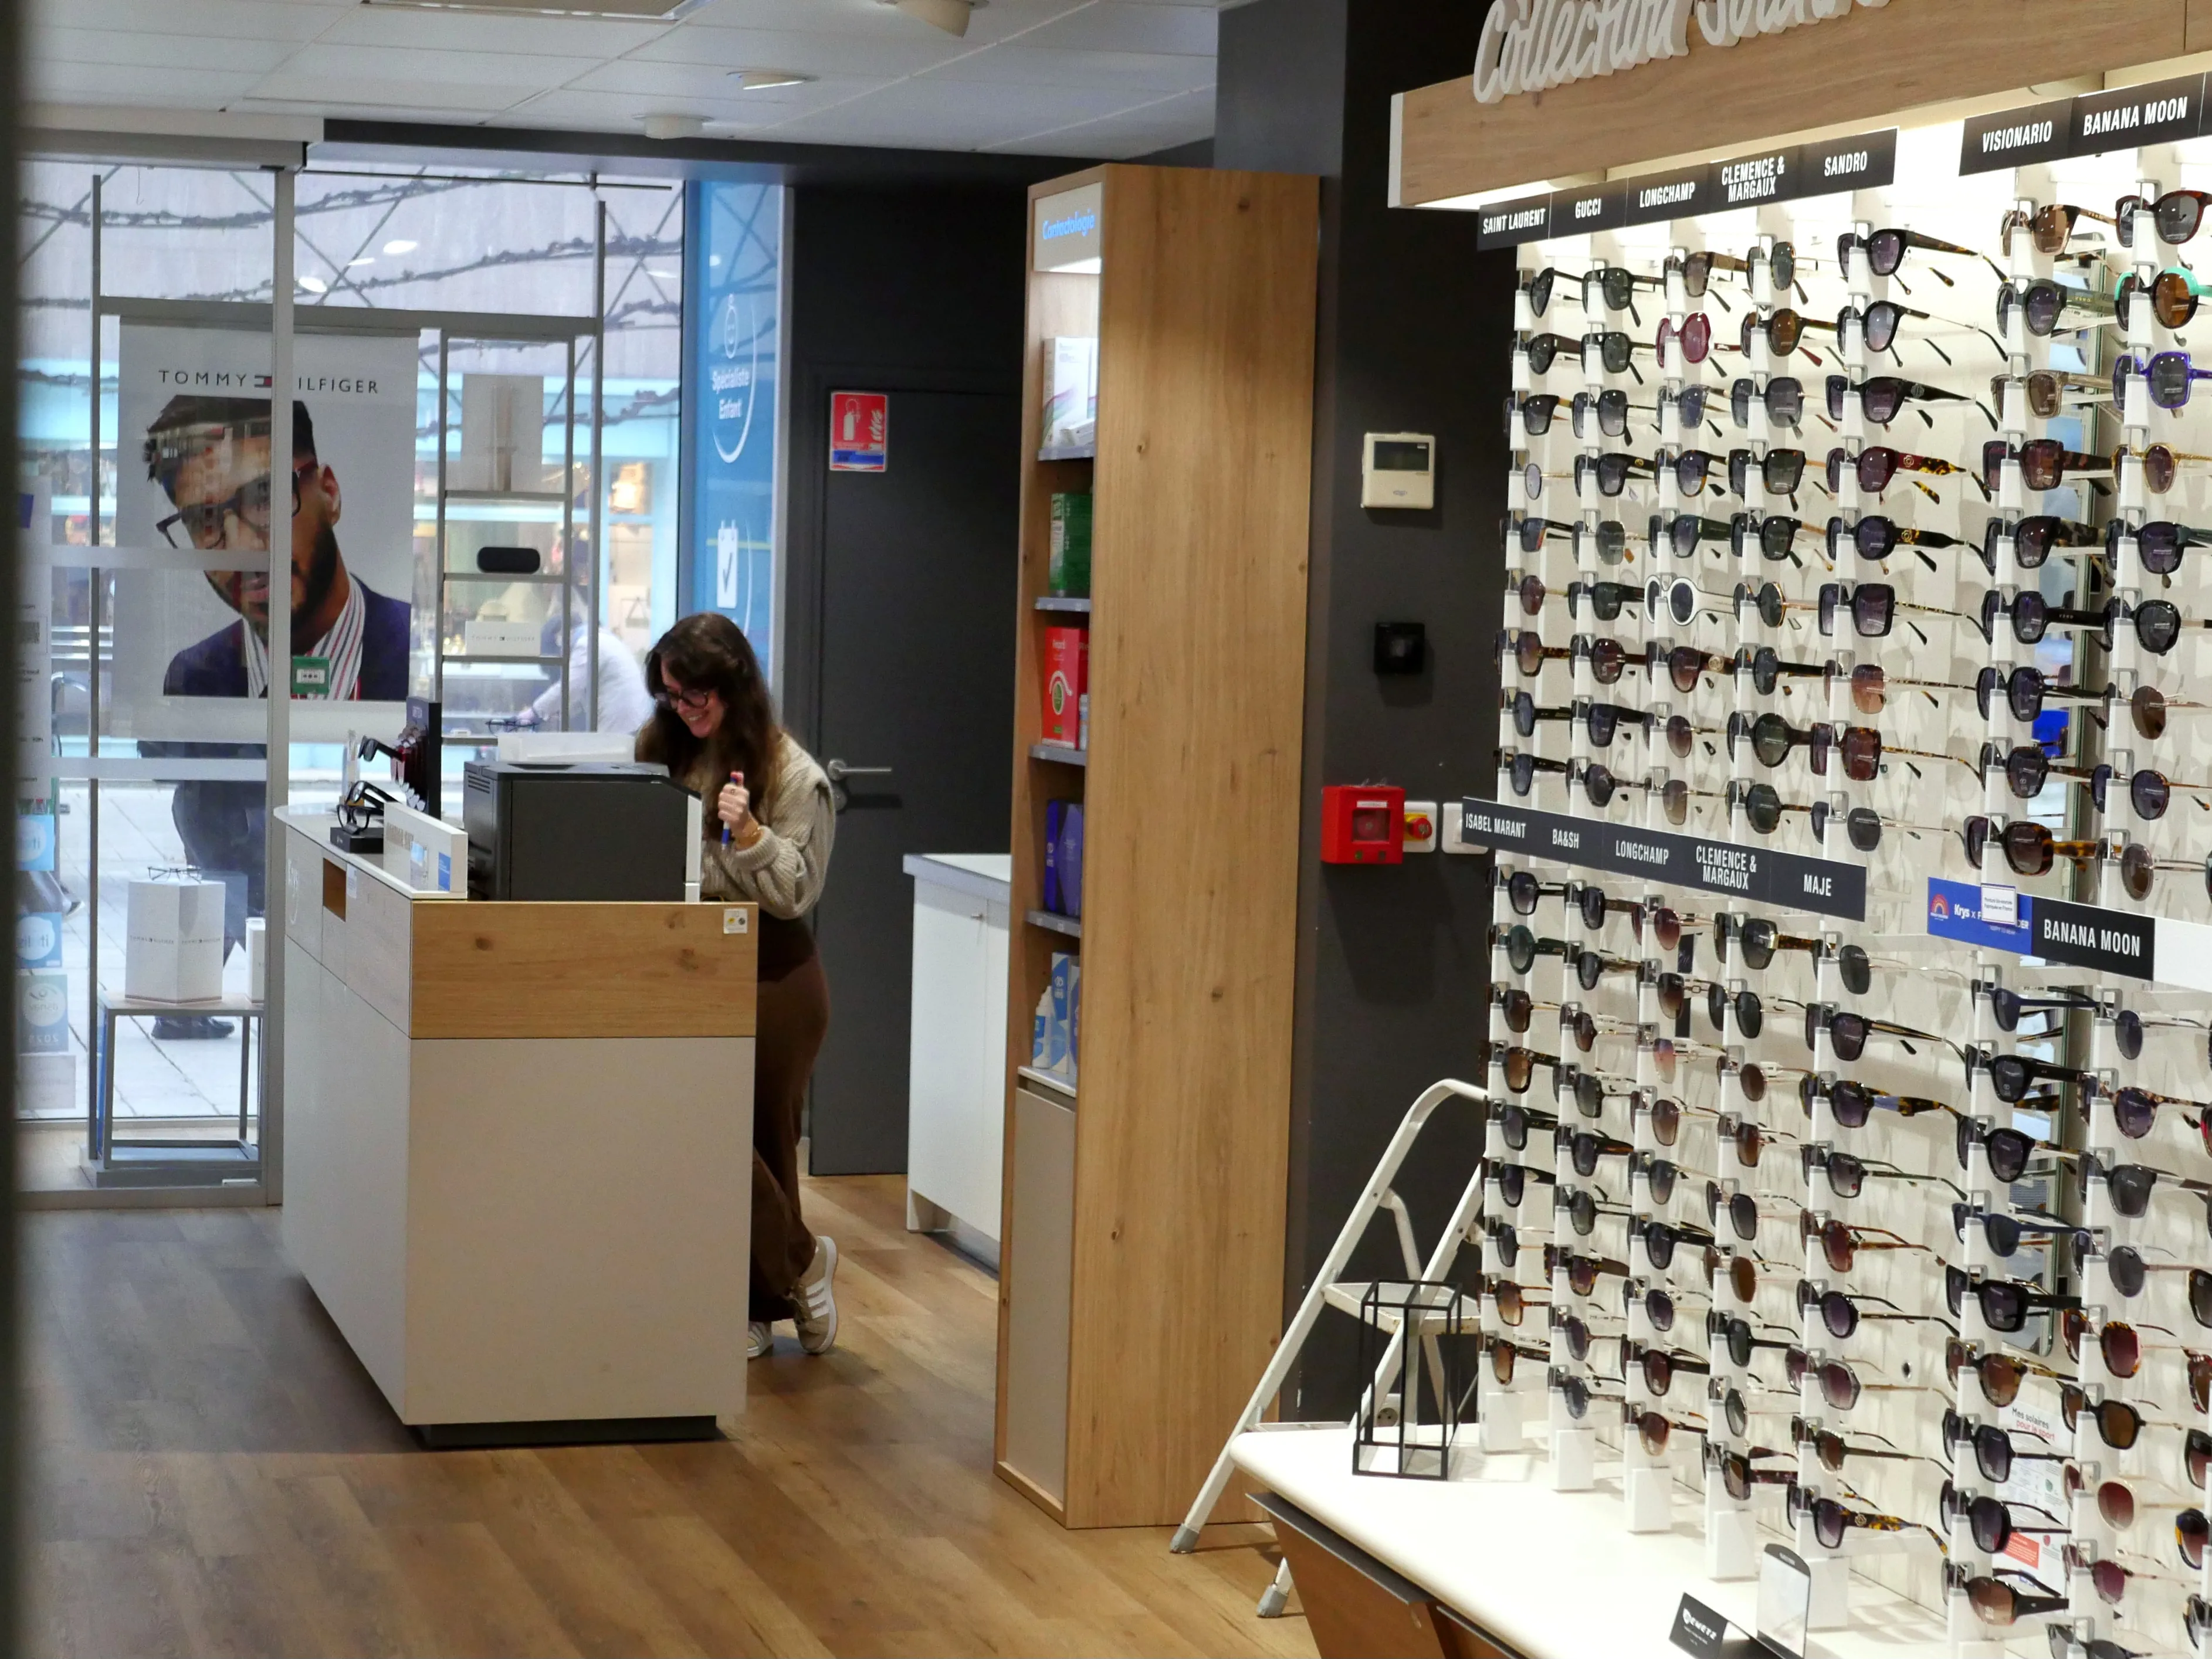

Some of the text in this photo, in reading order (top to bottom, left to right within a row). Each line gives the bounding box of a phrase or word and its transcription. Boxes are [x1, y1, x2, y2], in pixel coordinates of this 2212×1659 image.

[2082, 96, 2188, 136] BANANA MOON
[1982, 121, 2053, 153] VISIONARIO
[1721, 155, 1785, 186] CLEMENCE &
[1824, 151, 1868, 177] SANDRO
[1639, 181, 1696, 208] LONGCHAMP
[1728, 176, 1777, 202] MARGAUX
[1482, 208, 1546, 235] SAINT LAURENT
[1574, 198, 1602, 219] GUCCI
[158, 370, 378, 394] TOMMY ILFIGER
[1465, 812, 1526, 839] ISABEL MARANT
[1552, 828, 1580, 849] BA&SH
[1615, 840, 1669, 866] LONGCHAMP
[1696, 845, 1757, 873] CLEMENCE &
[1702, 864, 1749, 890] MARGAUX
[1803, 874, 1832, 897] MAJE
[1954, 903, 1970, 920] Krys
[2044, 918, 2140, 958] BANANA MOON
